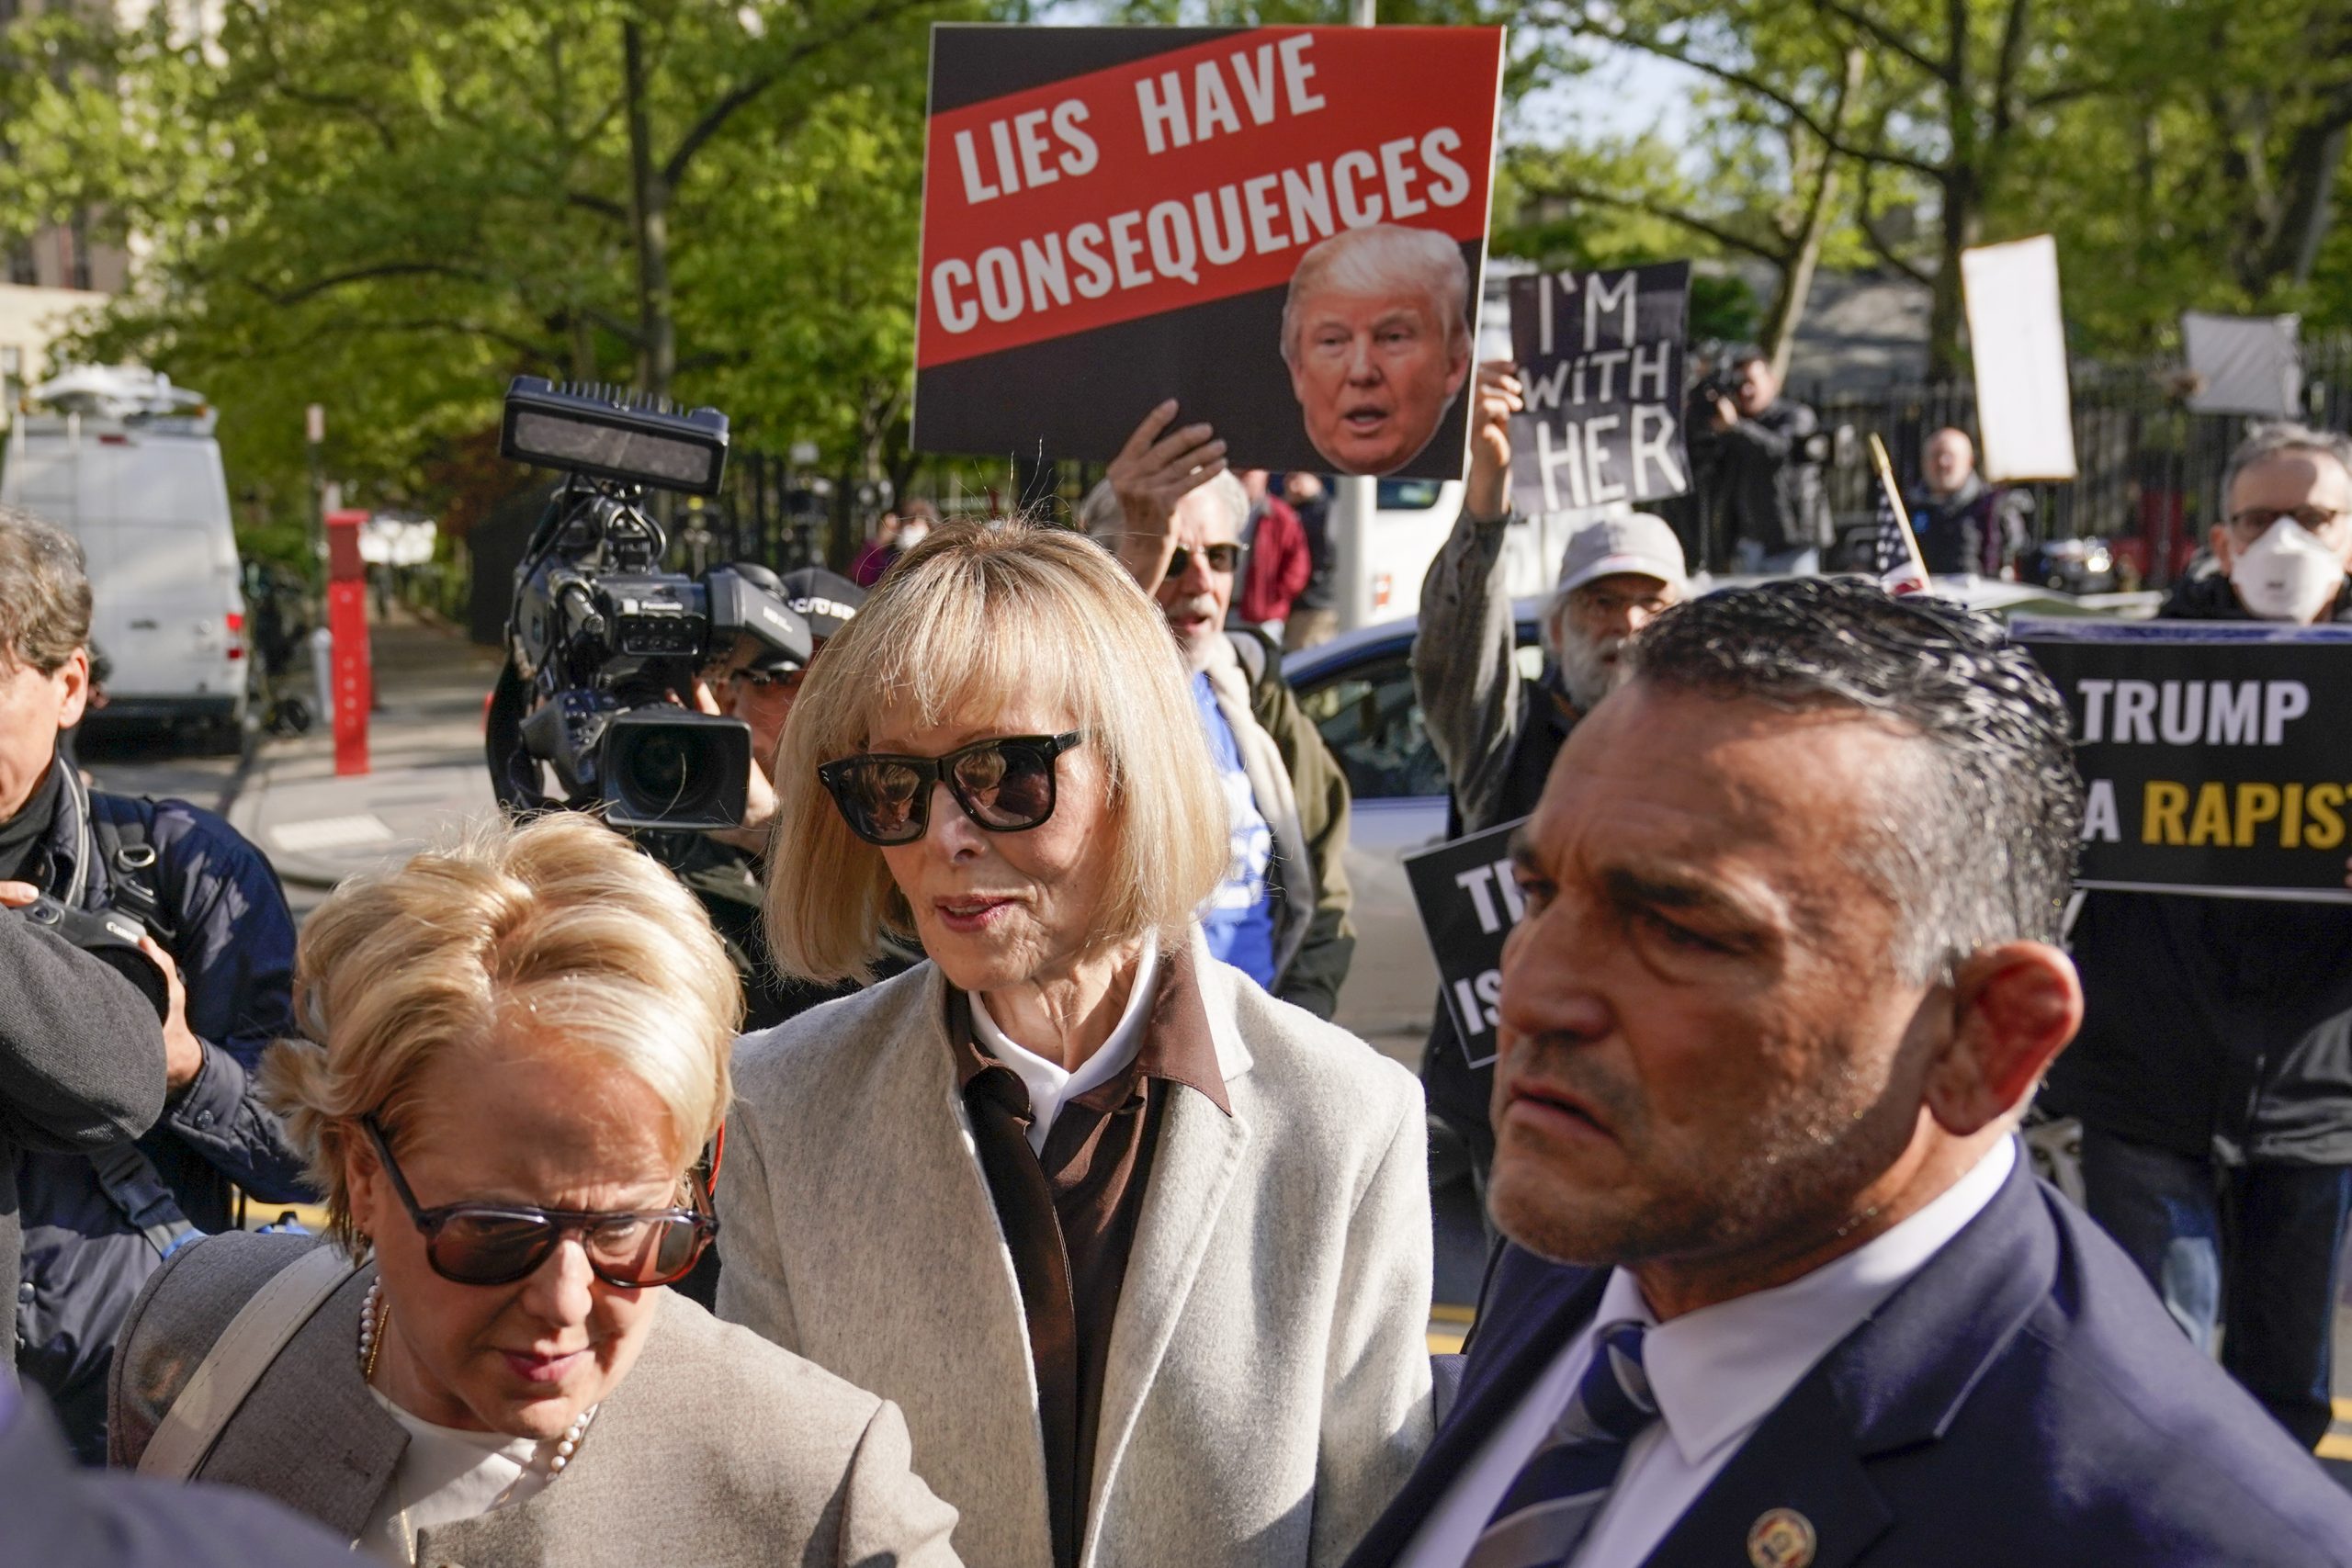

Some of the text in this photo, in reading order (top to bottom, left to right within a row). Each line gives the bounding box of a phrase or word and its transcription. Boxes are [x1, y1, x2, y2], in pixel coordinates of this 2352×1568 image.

[954, 33, 1325, 204] LIES HAVE
[931, 127, 1471, 334] CONSEQUENCES
[1539, 270, 1637, 355] I'M
[1536, 403, 1687, 510] HER
[2076, 679, 2310, 745] TRUMP
[2080, 779, 2352, 850] A RAPIS
